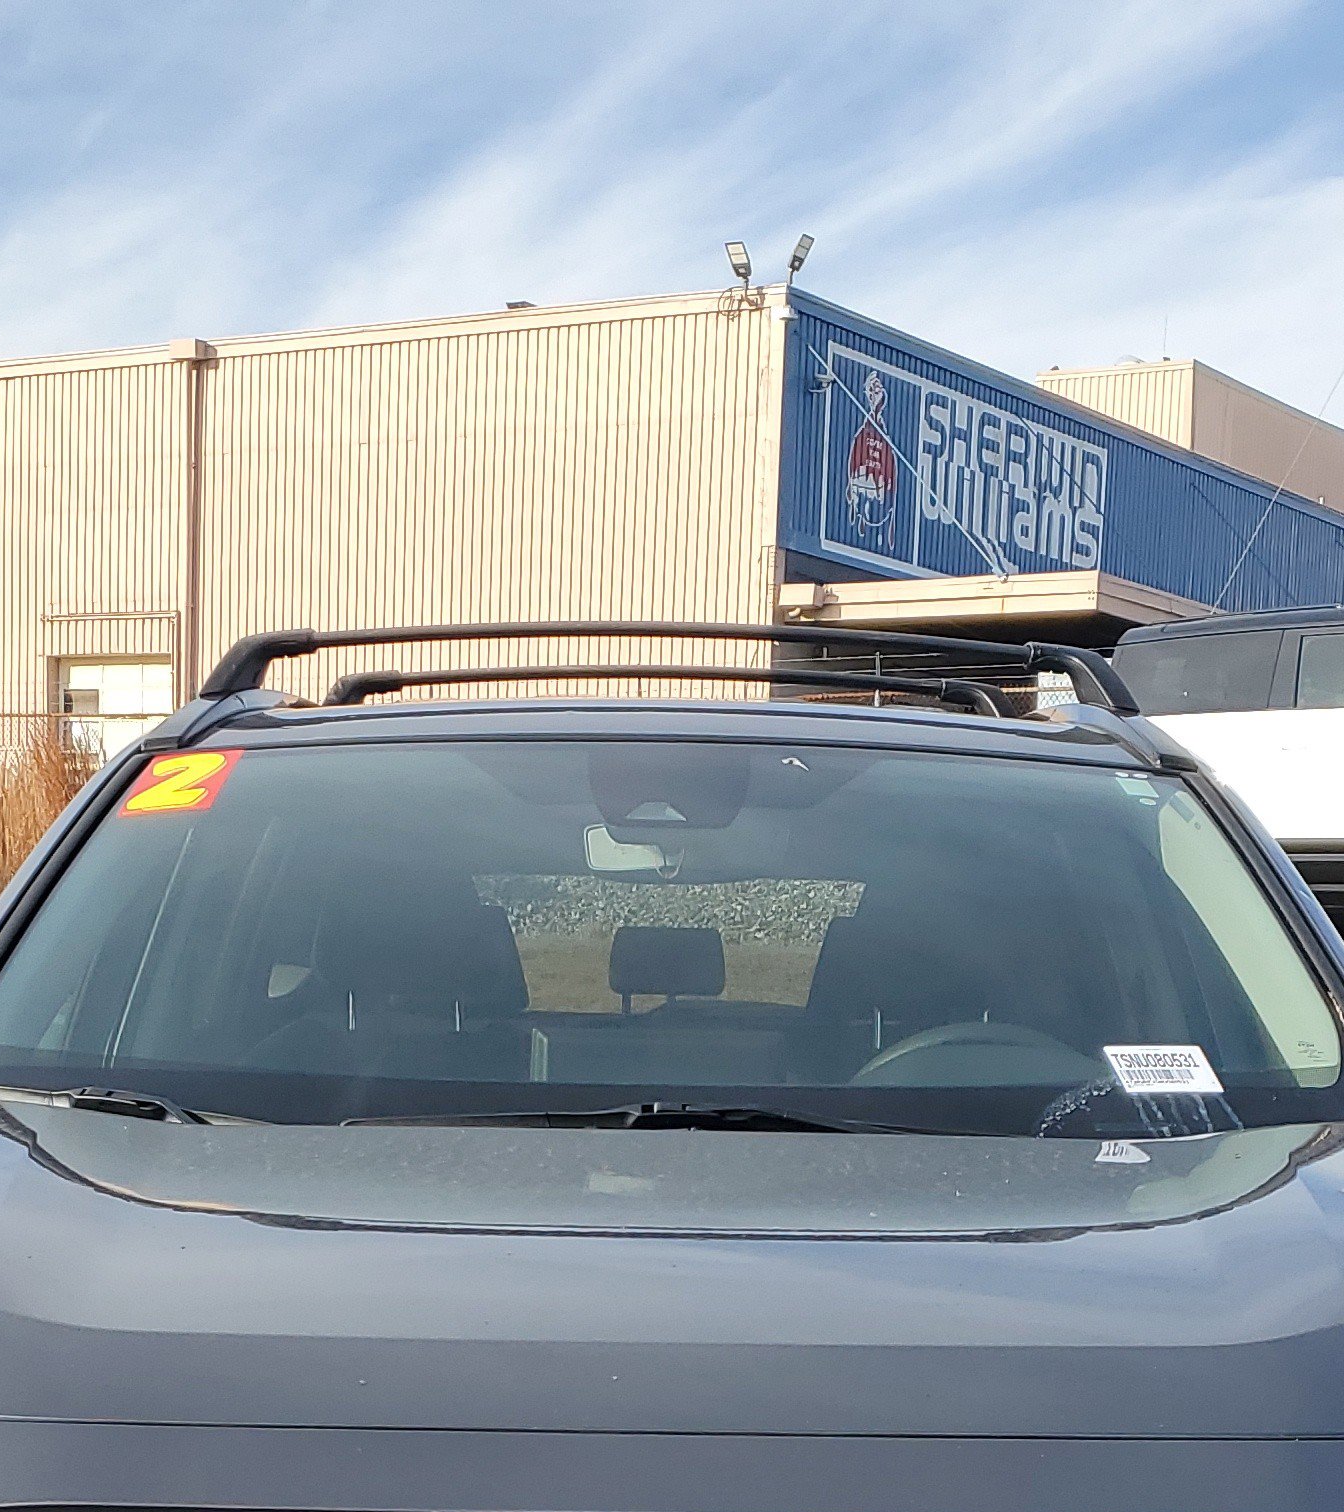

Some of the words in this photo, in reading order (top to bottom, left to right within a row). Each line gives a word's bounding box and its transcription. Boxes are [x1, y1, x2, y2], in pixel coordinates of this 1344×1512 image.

[922, 391, 1104, 515] SHERWIN
[921, 460, 1103, 569] Williams
[126, 753, 228, 812] 2
[1111, 1053, 1200, 1068] TSNU080531
